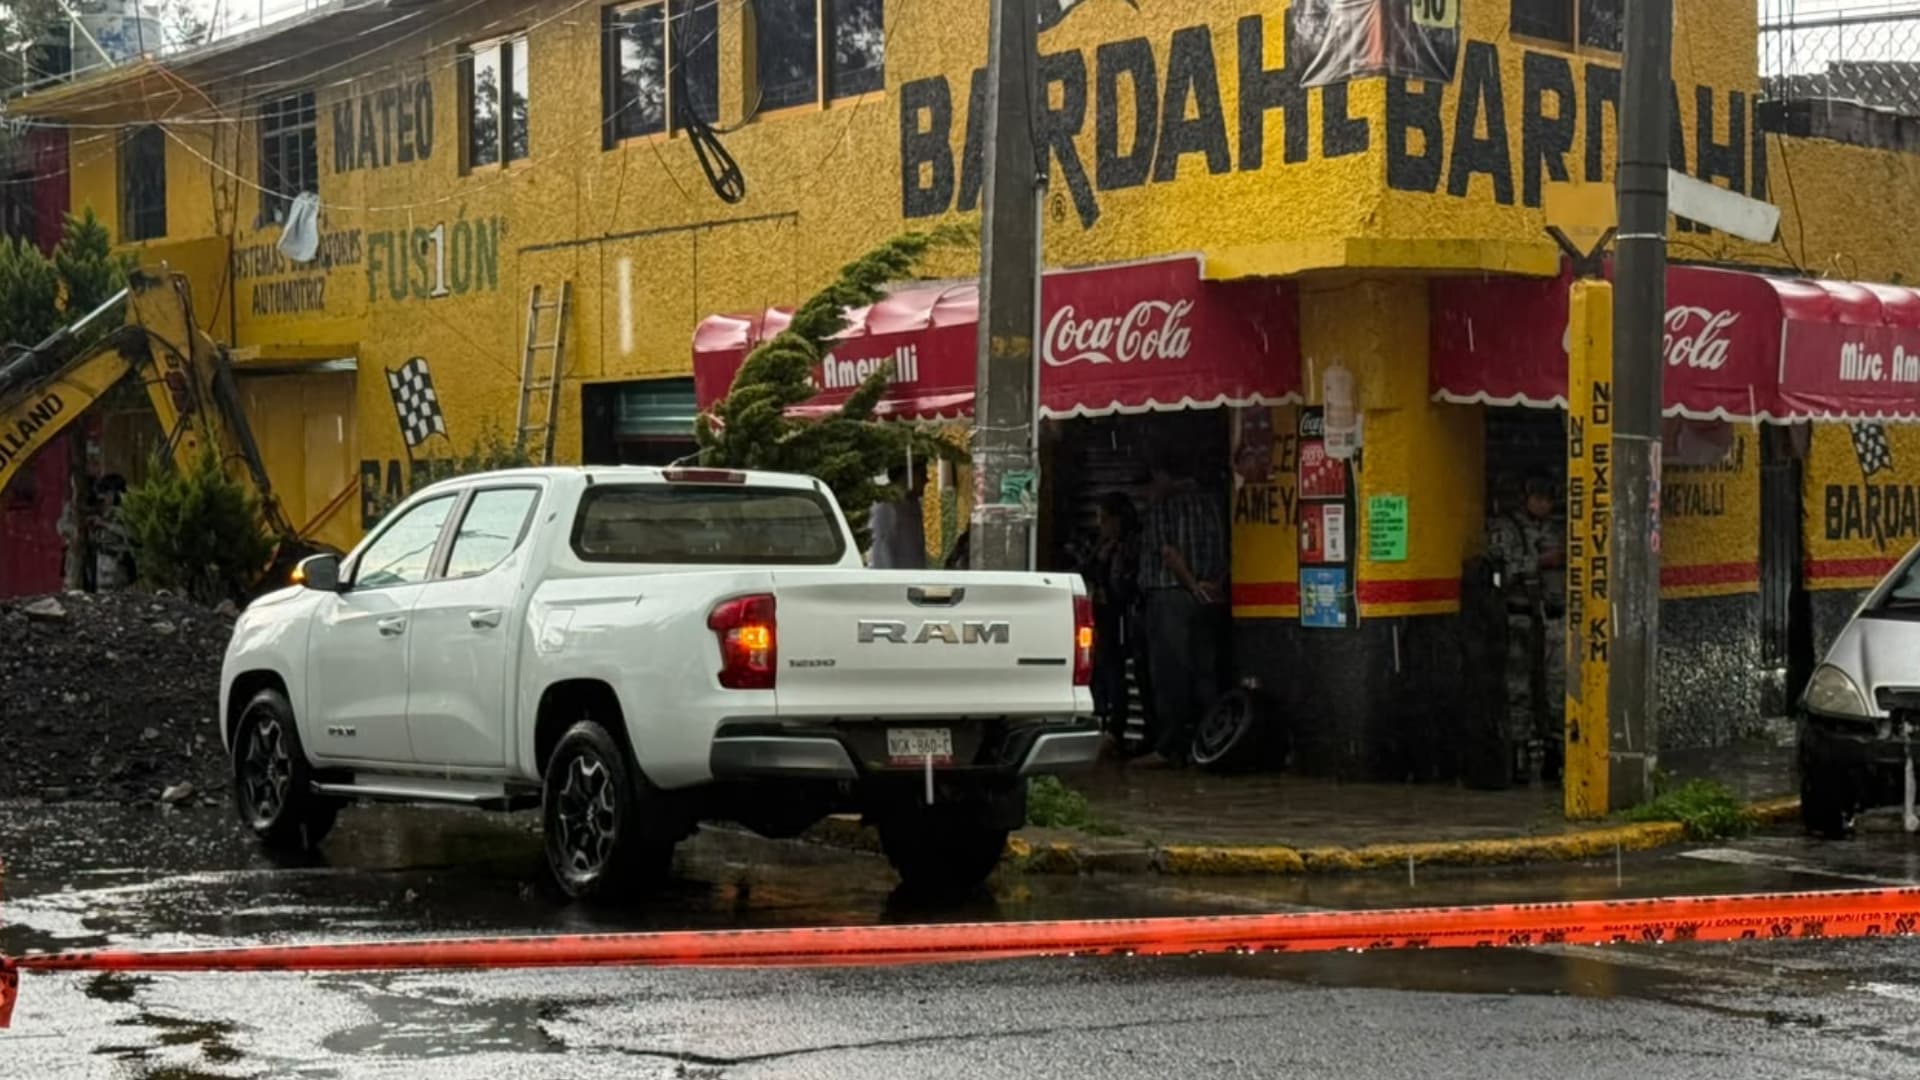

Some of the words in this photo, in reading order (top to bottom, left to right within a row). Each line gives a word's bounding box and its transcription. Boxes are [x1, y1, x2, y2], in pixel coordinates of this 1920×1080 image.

[333, 79, 434, 174] MATEO
[1043, 299, 1195, 367] Coca-Cola
[1839, 341, 1887, 382] Misc.
[1891, 344, 1920, 383] Am
[1591, 381, 1610, 424] NO
[1569, 416, 1585, 458] NO
[1234, 484, 1298, 531] AMEY
[1825, 484, 1920, 553] BARDA
[857, 620, 1010, 644] RAM
